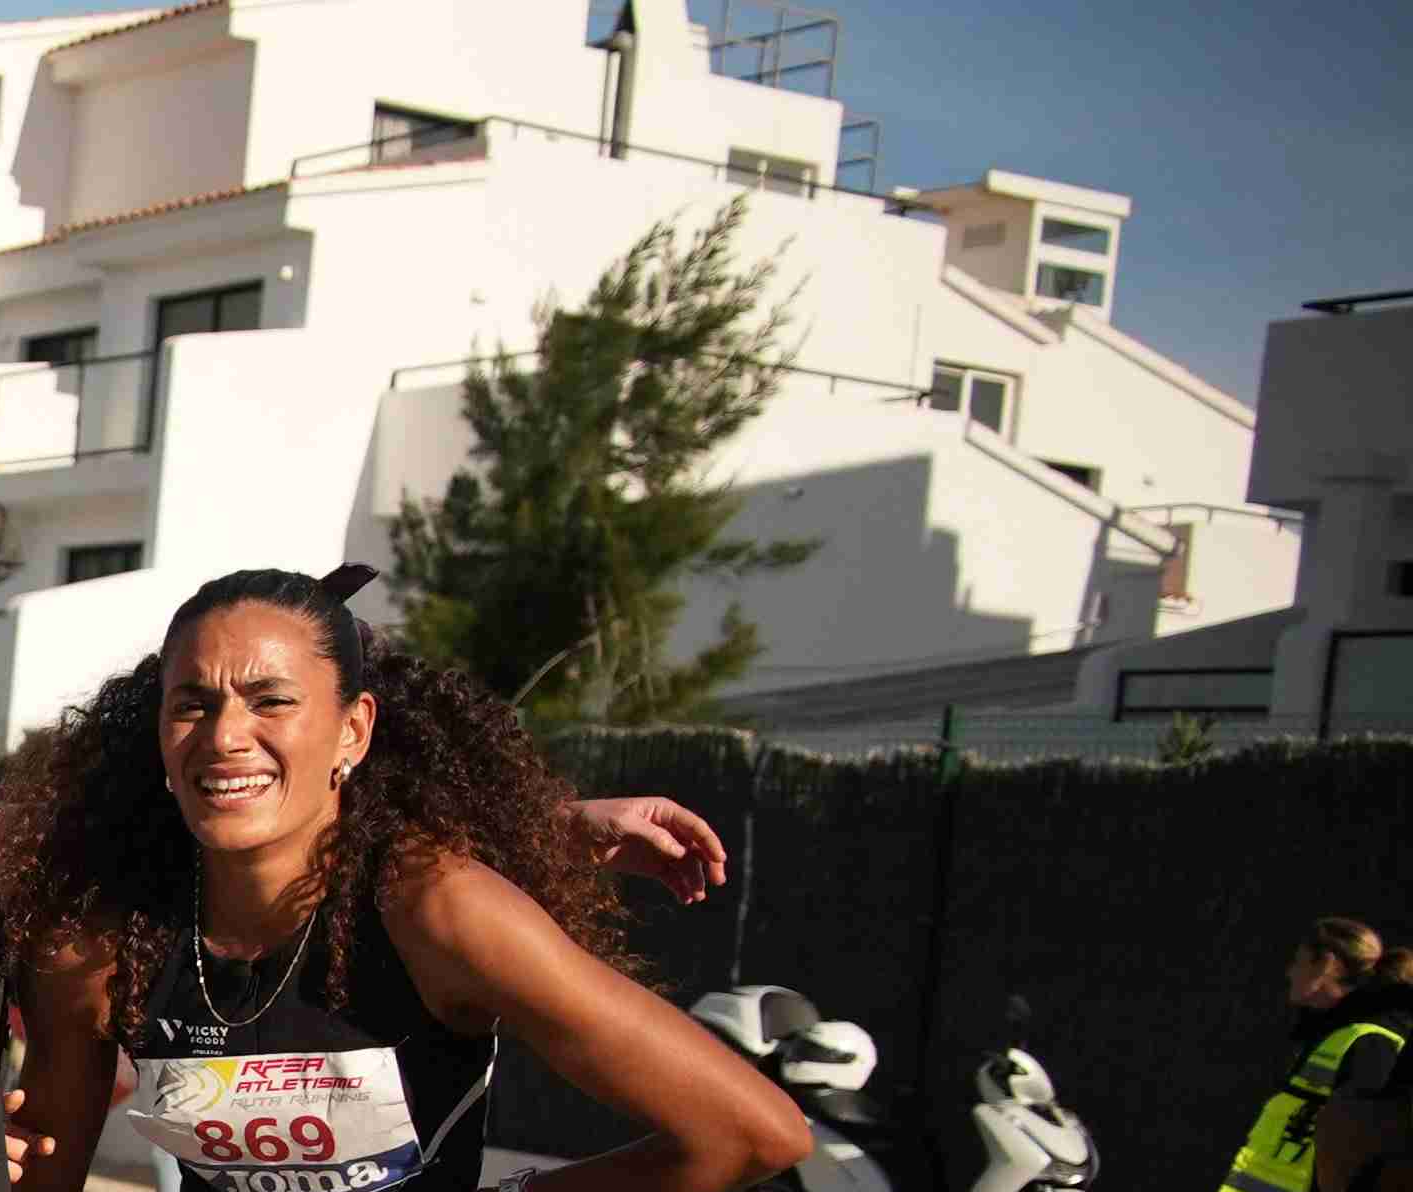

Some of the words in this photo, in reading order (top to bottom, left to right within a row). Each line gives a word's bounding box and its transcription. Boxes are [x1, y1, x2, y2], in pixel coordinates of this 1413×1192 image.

[186, 1025, 229, 1037] VICKY
[235, 1076, 364, 1094] ATLETISMO
[194, 1115, 337, 1164] 869
